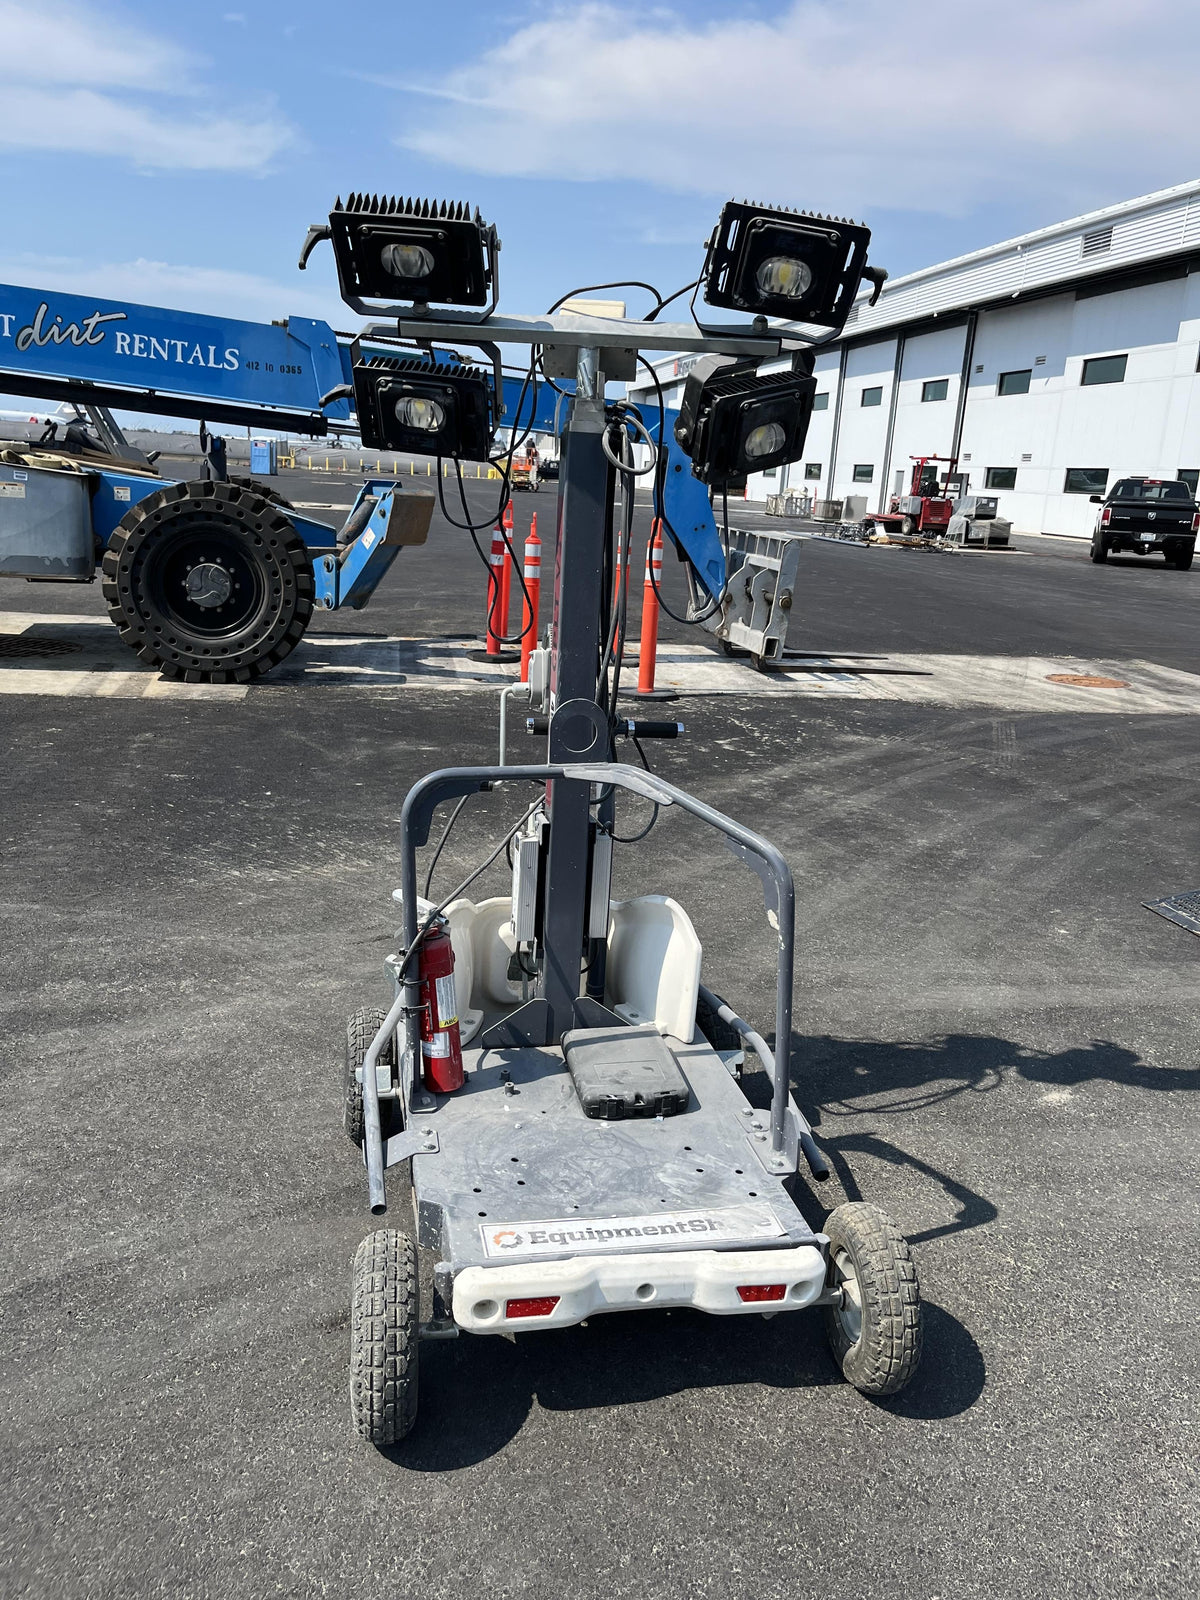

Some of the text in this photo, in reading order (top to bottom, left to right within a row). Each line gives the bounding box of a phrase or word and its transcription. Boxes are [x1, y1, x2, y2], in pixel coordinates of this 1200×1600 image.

[16, 302, 127, 351] dirt
[115, 331, 240, 371] RENTALS
[280, 364, 303, 375] 0365
[528, 1216, 772, 1245] EquipmentSh
